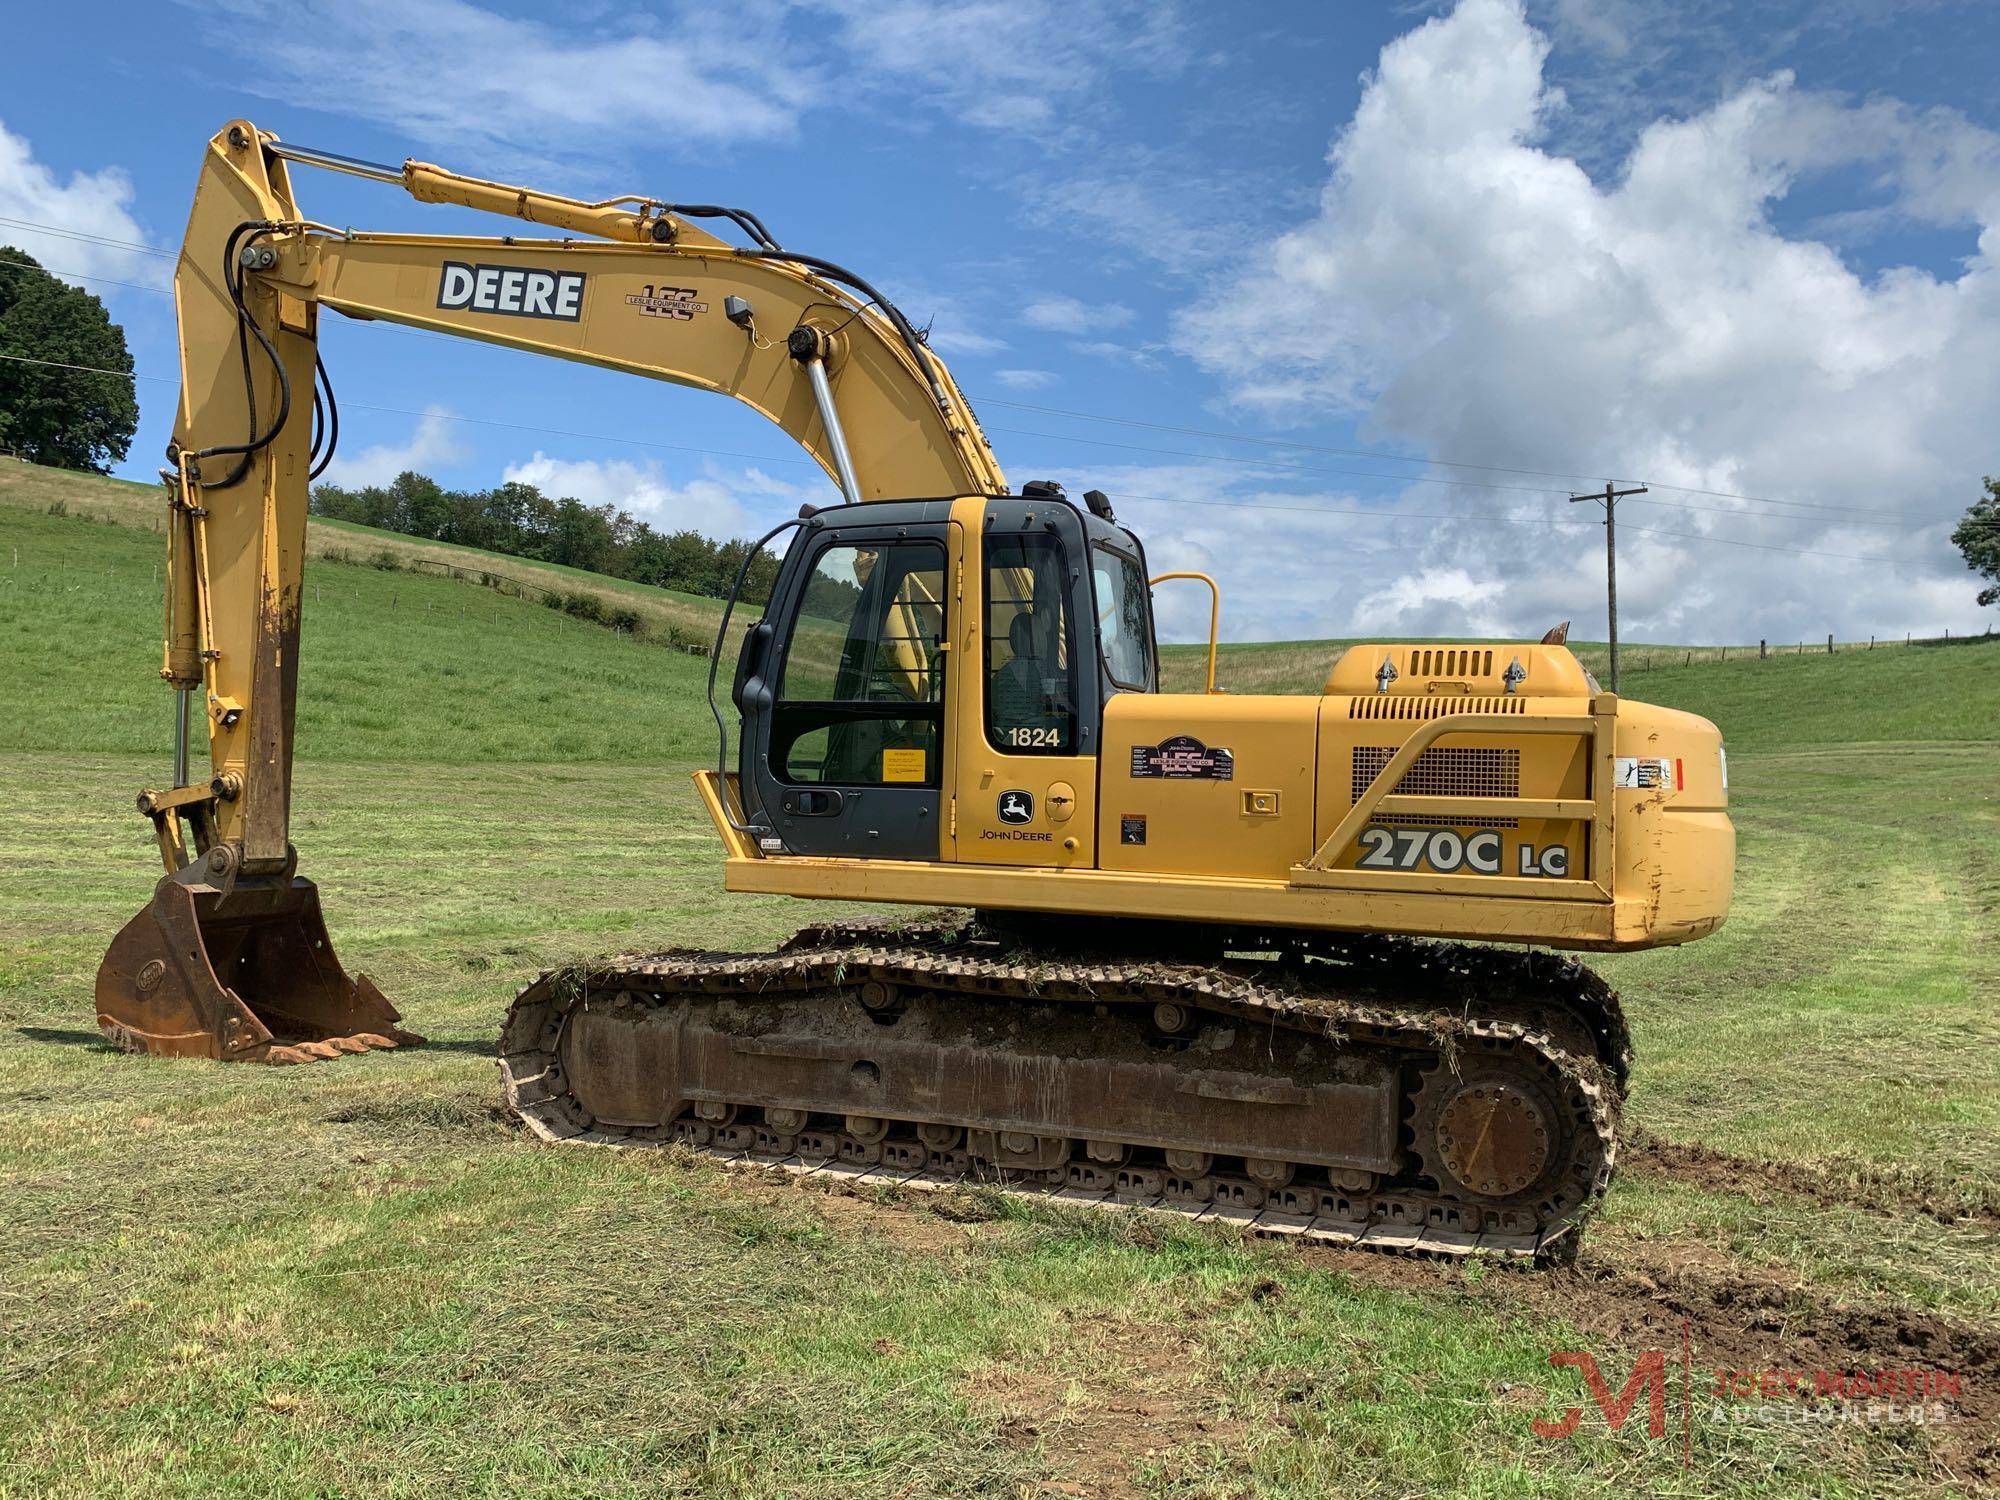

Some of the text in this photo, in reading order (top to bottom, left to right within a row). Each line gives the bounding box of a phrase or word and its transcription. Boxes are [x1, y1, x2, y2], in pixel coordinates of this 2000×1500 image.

[439, 264, 585, 320] DEERE
[630, 297, 652, 306] LESLIE
[652, 299, 690, 310] EQUIPMENT
[1009, 728, 1060, 747] 1824
[979, 829, 1053, 841] JOHN DEERE
[1362, 828, 1567, 876] 270C LC
